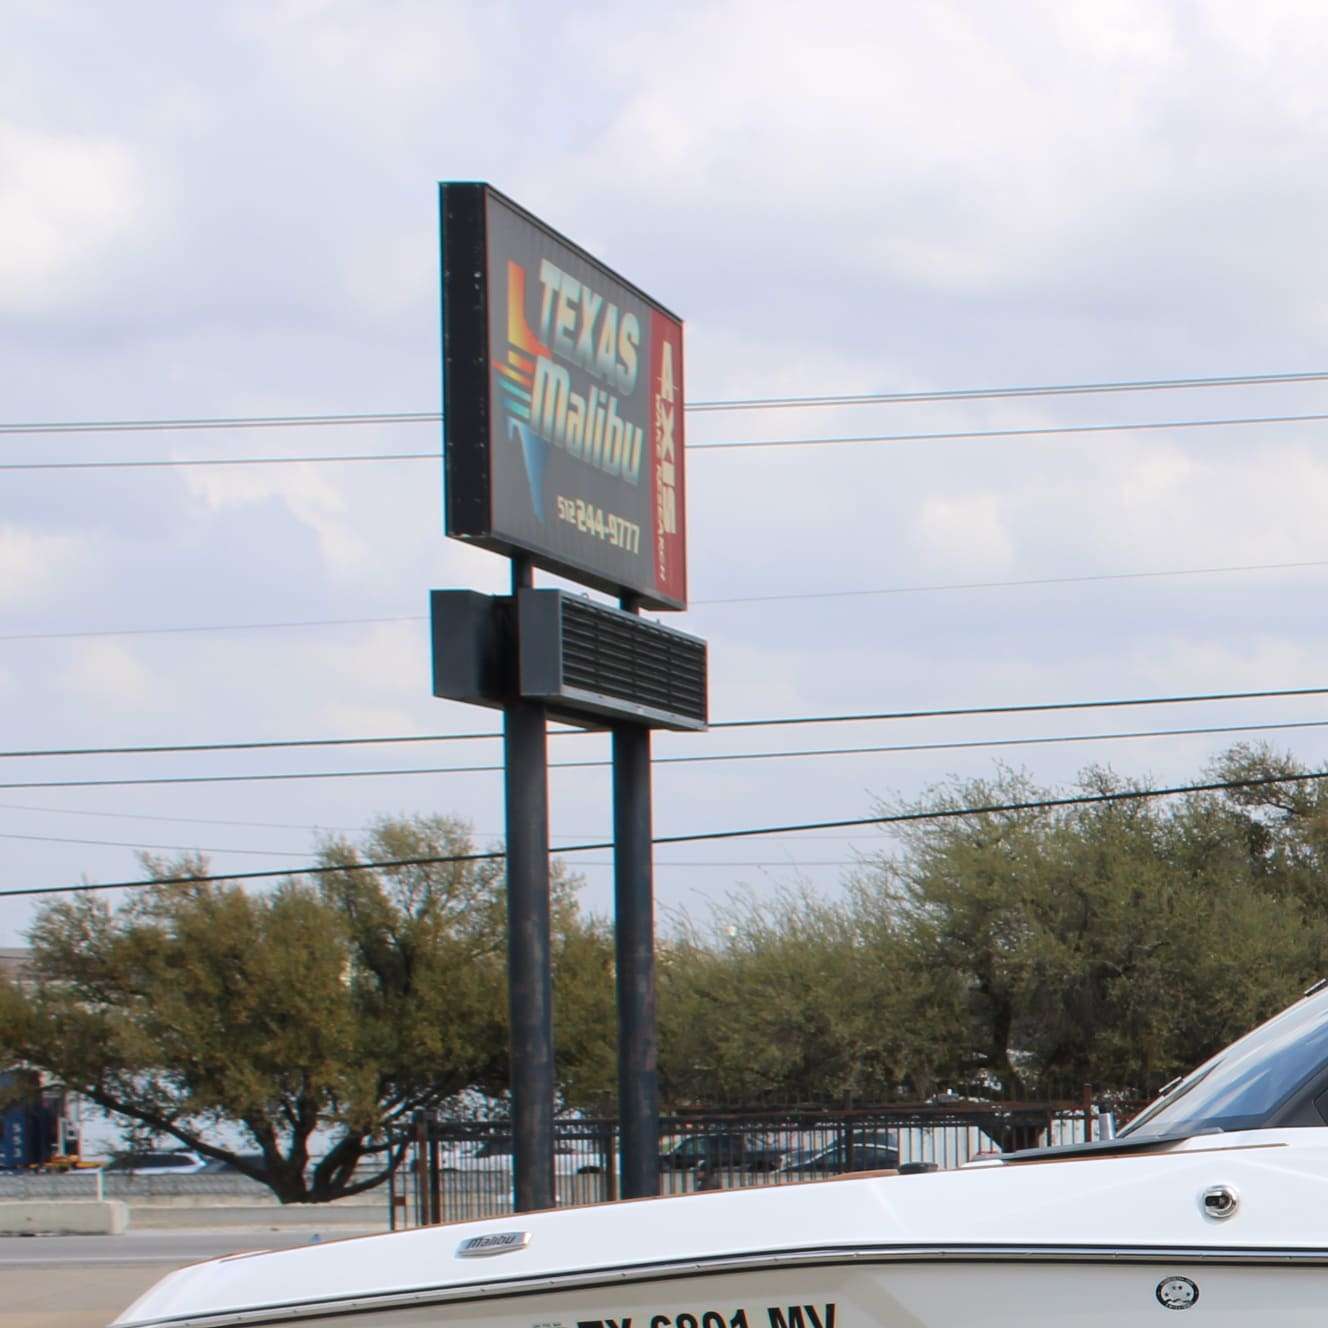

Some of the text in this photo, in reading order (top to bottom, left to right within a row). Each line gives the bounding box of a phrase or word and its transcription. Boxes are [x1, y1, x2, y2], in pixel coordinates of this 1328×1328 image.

[540, 258, 640, 396] TEXAS
[528, 354, 643, 485] Malibu
[660, 341, 676, 534] AXIS
[466, 1234, 517, 1249] Malibu
